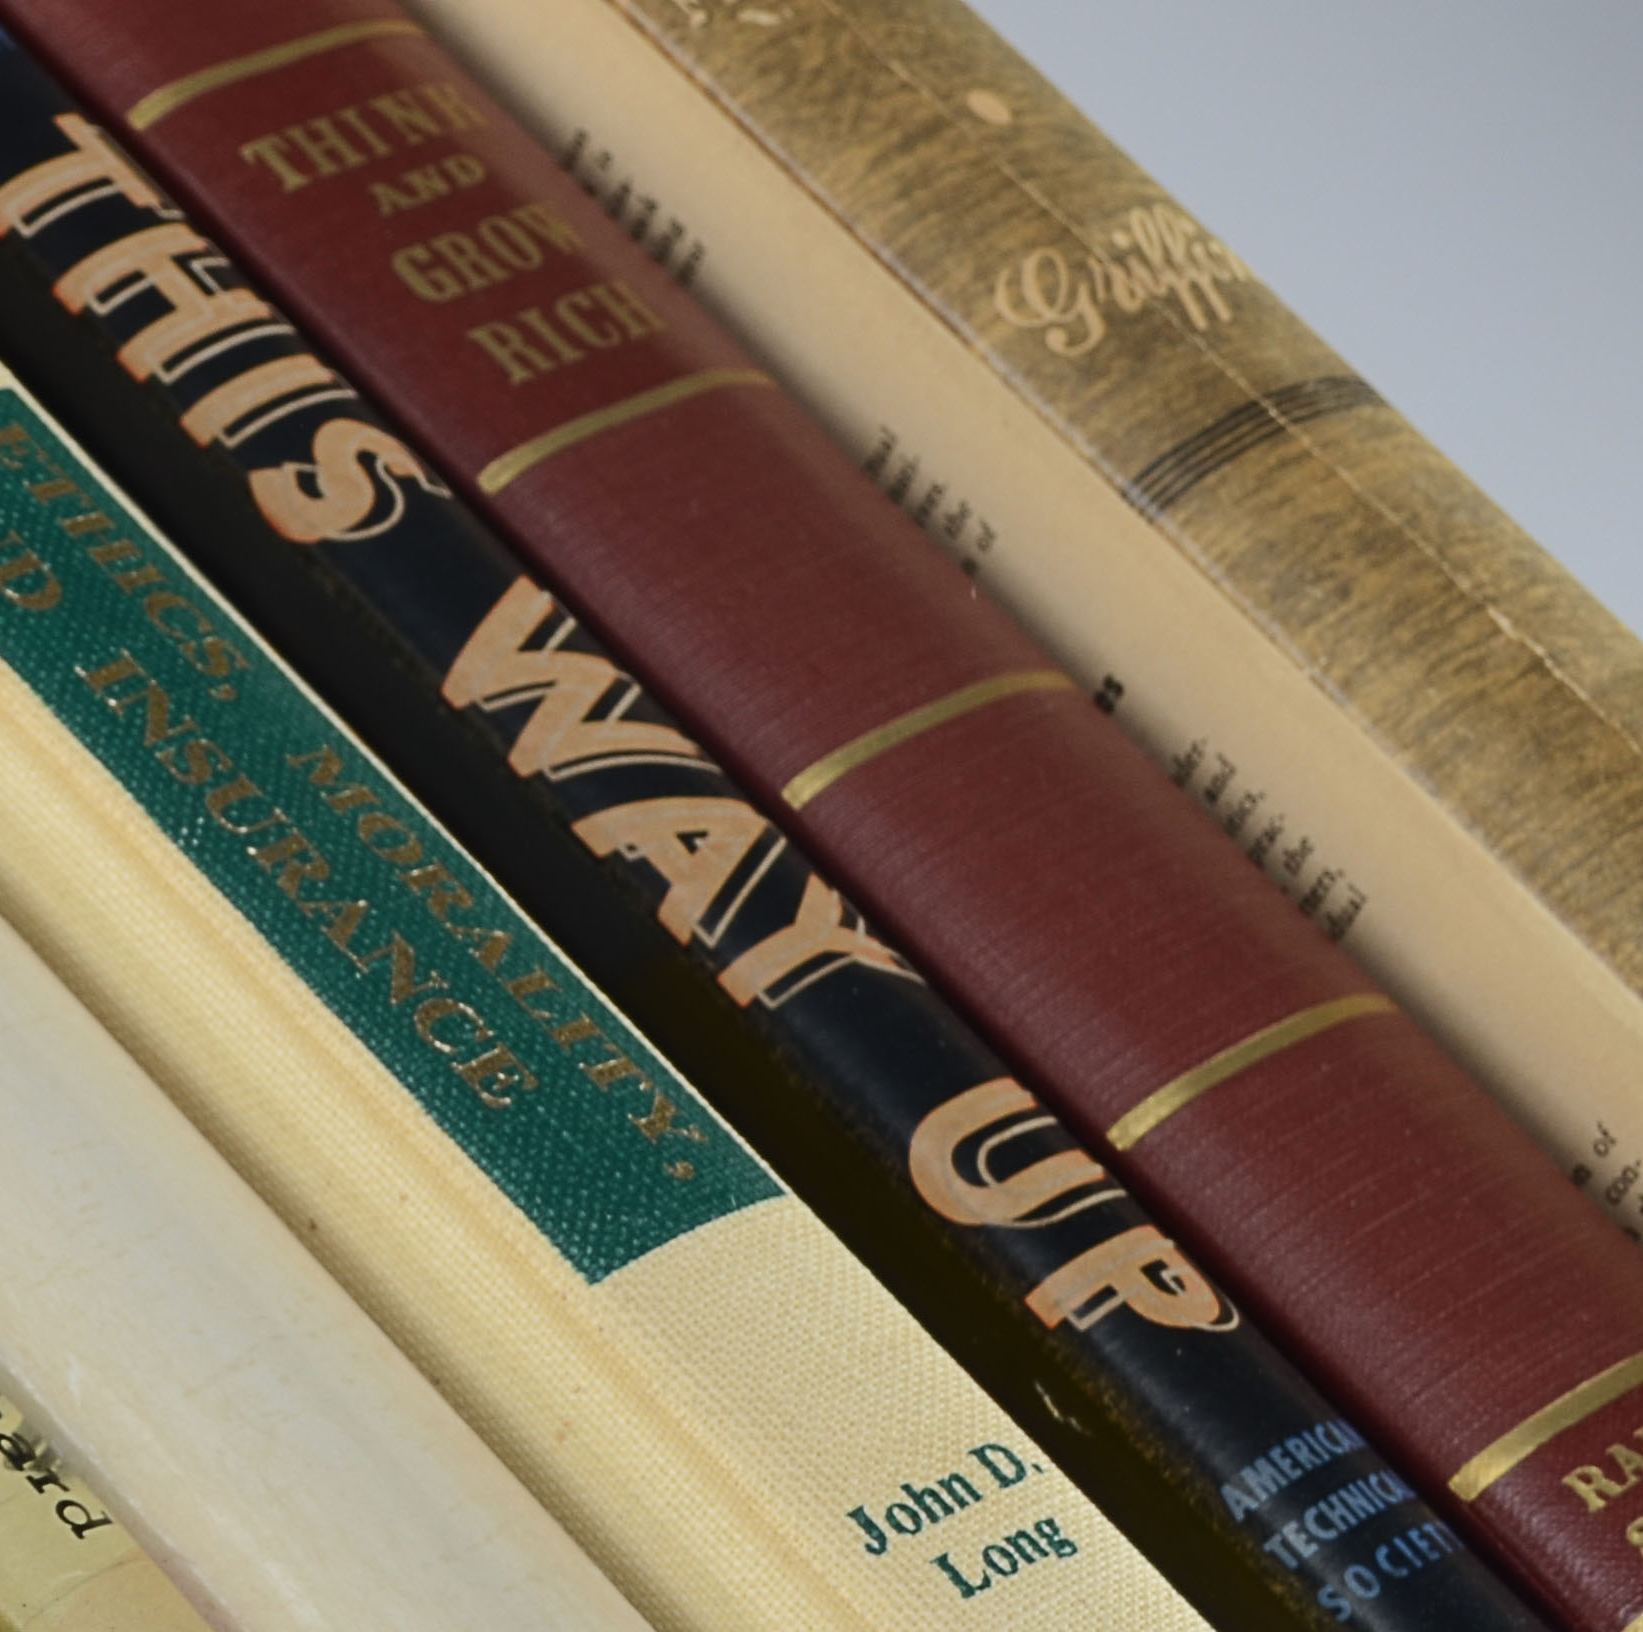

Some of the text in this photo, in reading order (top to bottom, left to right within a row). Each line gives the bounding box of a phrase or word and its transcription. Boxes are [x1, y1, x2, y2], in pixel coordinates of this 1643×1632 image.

[239, 82, 487, 192] THINK
[368, 153, 486, 216] AND
[391, 201, 585, 302] GROW
[467, 280, 668, 385] RICH
[74, 648, 542, 1111] INSURANCE
[286, 743, 709, 1181] MORALITY,
[440, 574, 925, 1008] WAY
[910, 1077, 1240, 1331] UP
[845, 1441, 1045, 1557] John D.
[928, 1512, 1080, 1600] Long
